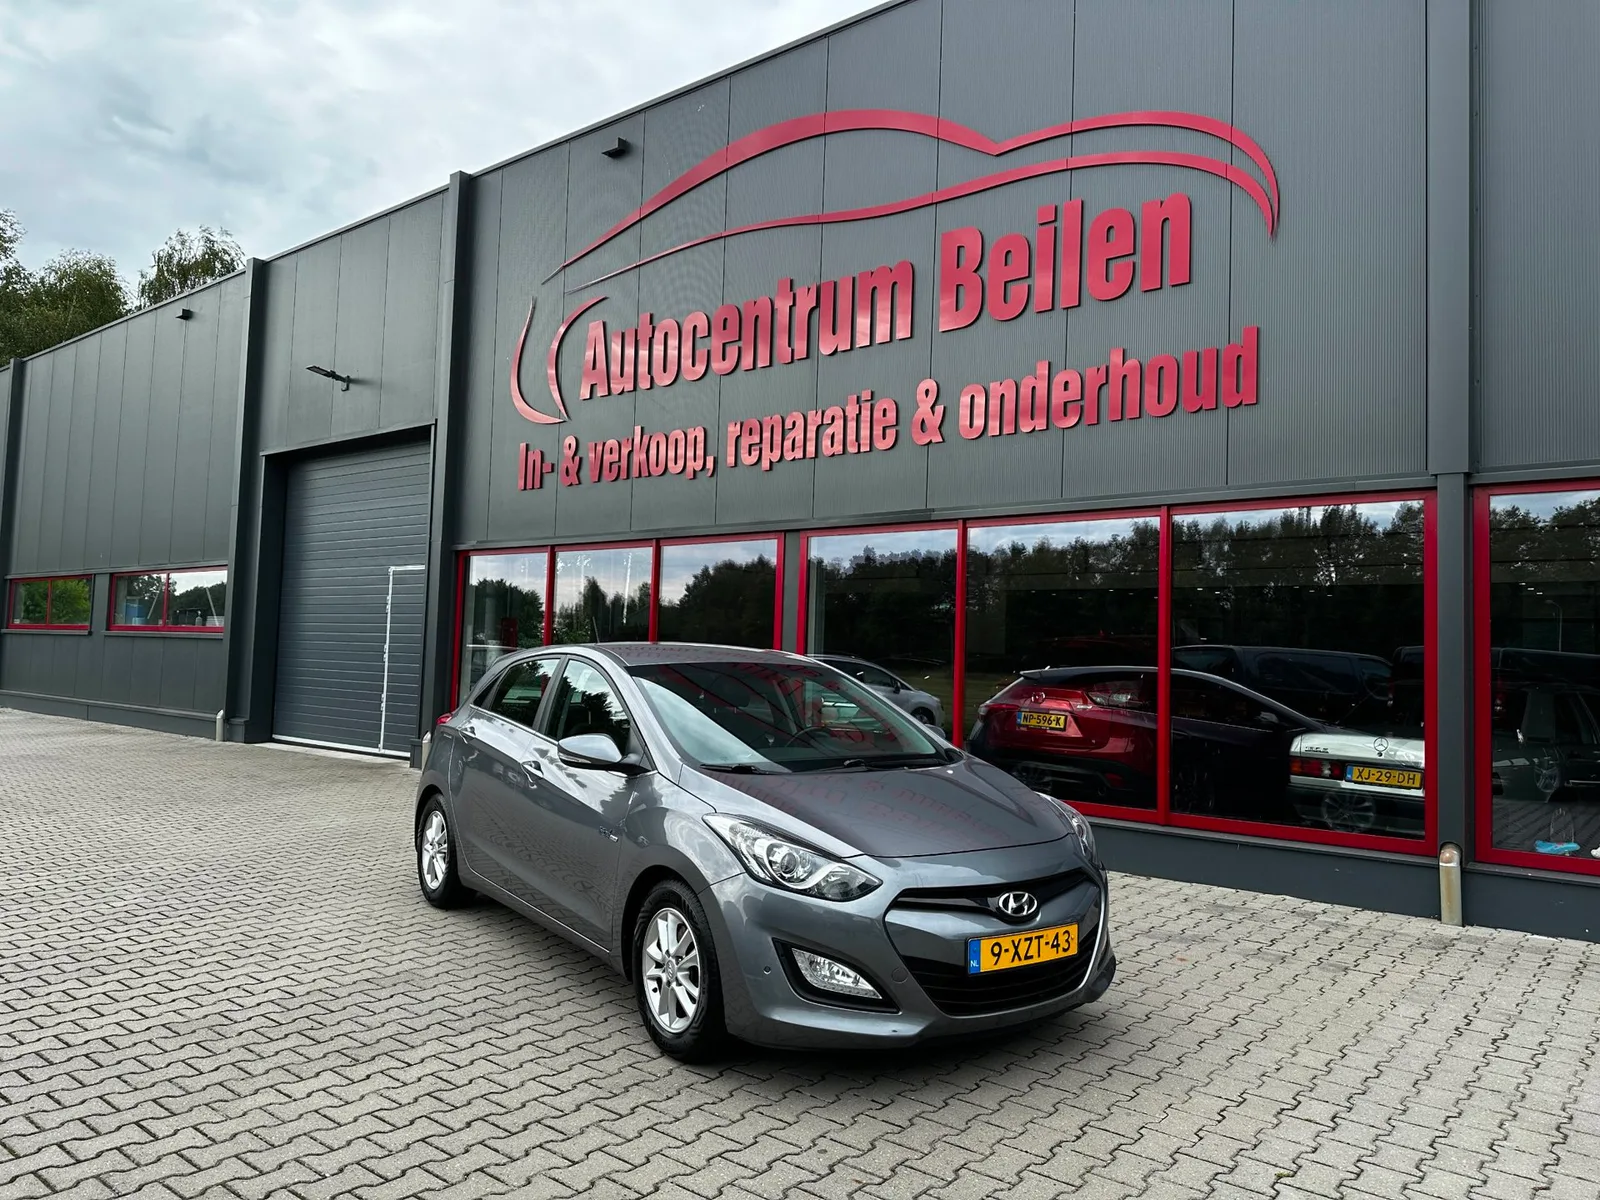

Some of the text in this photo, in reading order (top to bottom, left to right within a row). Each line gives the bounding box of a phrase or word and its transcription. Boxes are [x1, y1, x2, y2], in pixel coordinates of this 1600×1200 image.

[579, 193, 1191, 400] Autocentrum Beilen
[518, 326, 1259, 490] In- & verkoop, reparatie & onderhoud
[1022, 713, 1062, 727] NP-596-K
[1356, 768, 1416, 785] XJ-29-DH
[990, 930, 1071, 966] 9-XZT-43
[970, 960, 979, 968] NL
